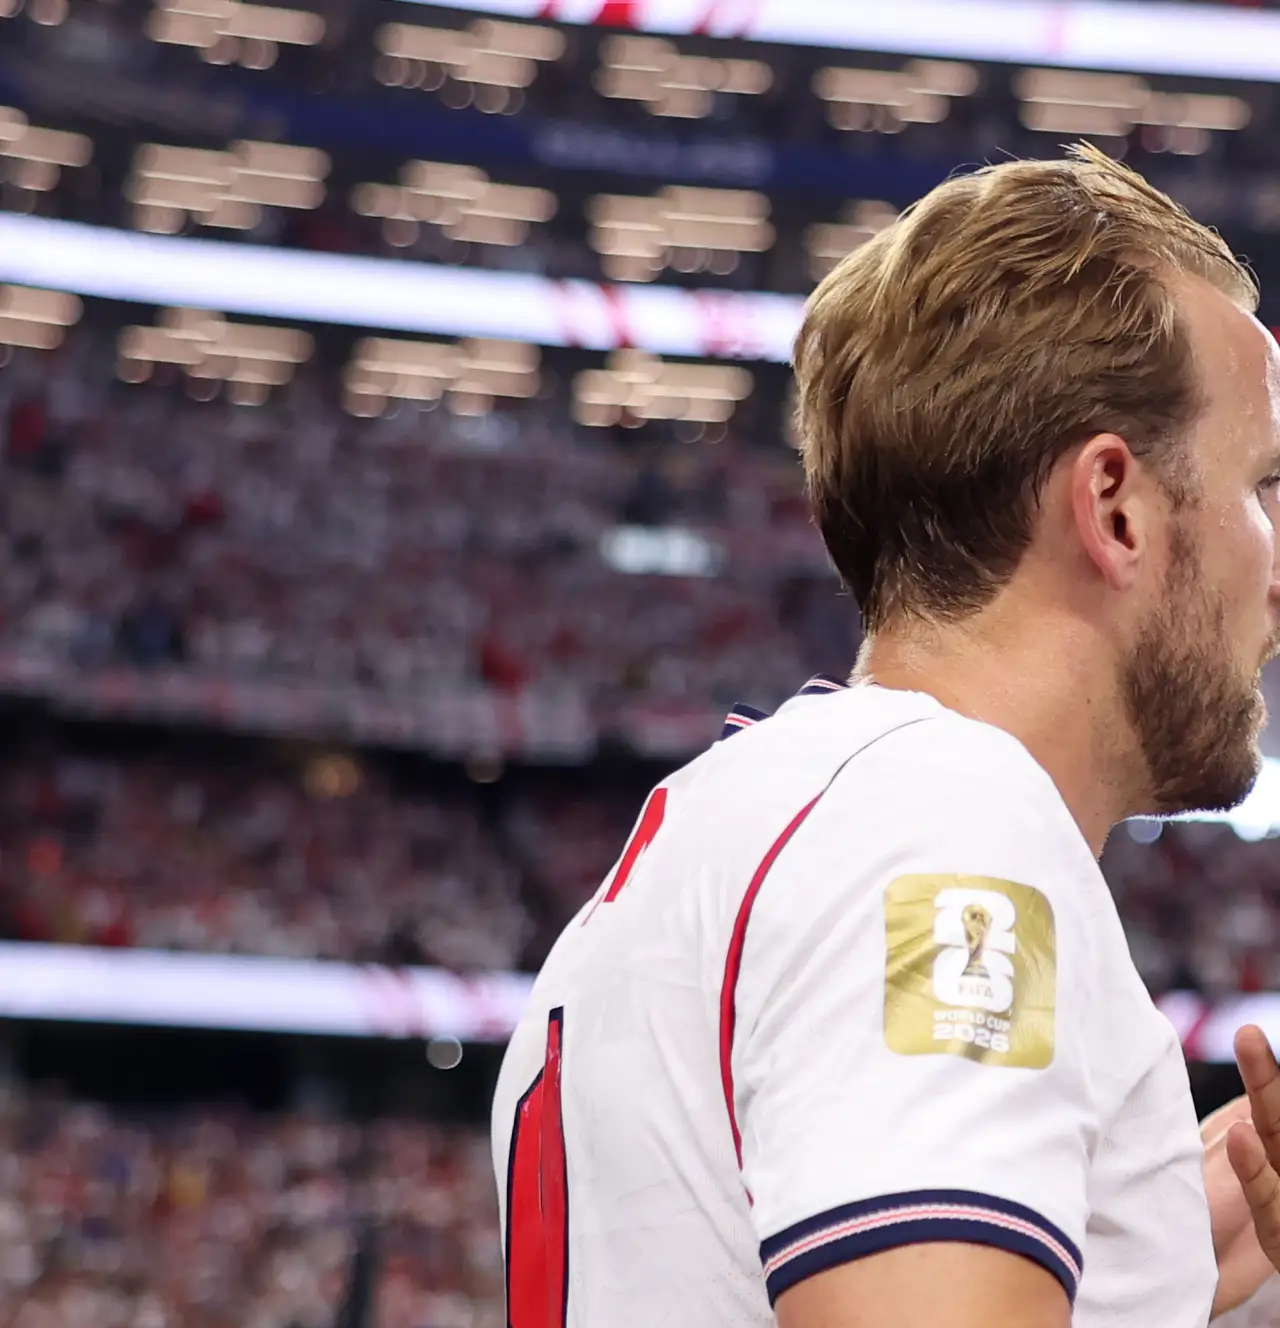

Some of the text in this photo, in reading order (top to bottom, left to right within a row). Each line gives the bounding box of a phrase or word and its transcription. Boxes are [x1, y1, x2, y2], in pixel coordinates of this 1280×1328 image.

[957, 982, 994, 999] FIFA
[933, 1009, 1011, 1032] WORLD CUP
[932, 1022, 1010, 1053] 2026
